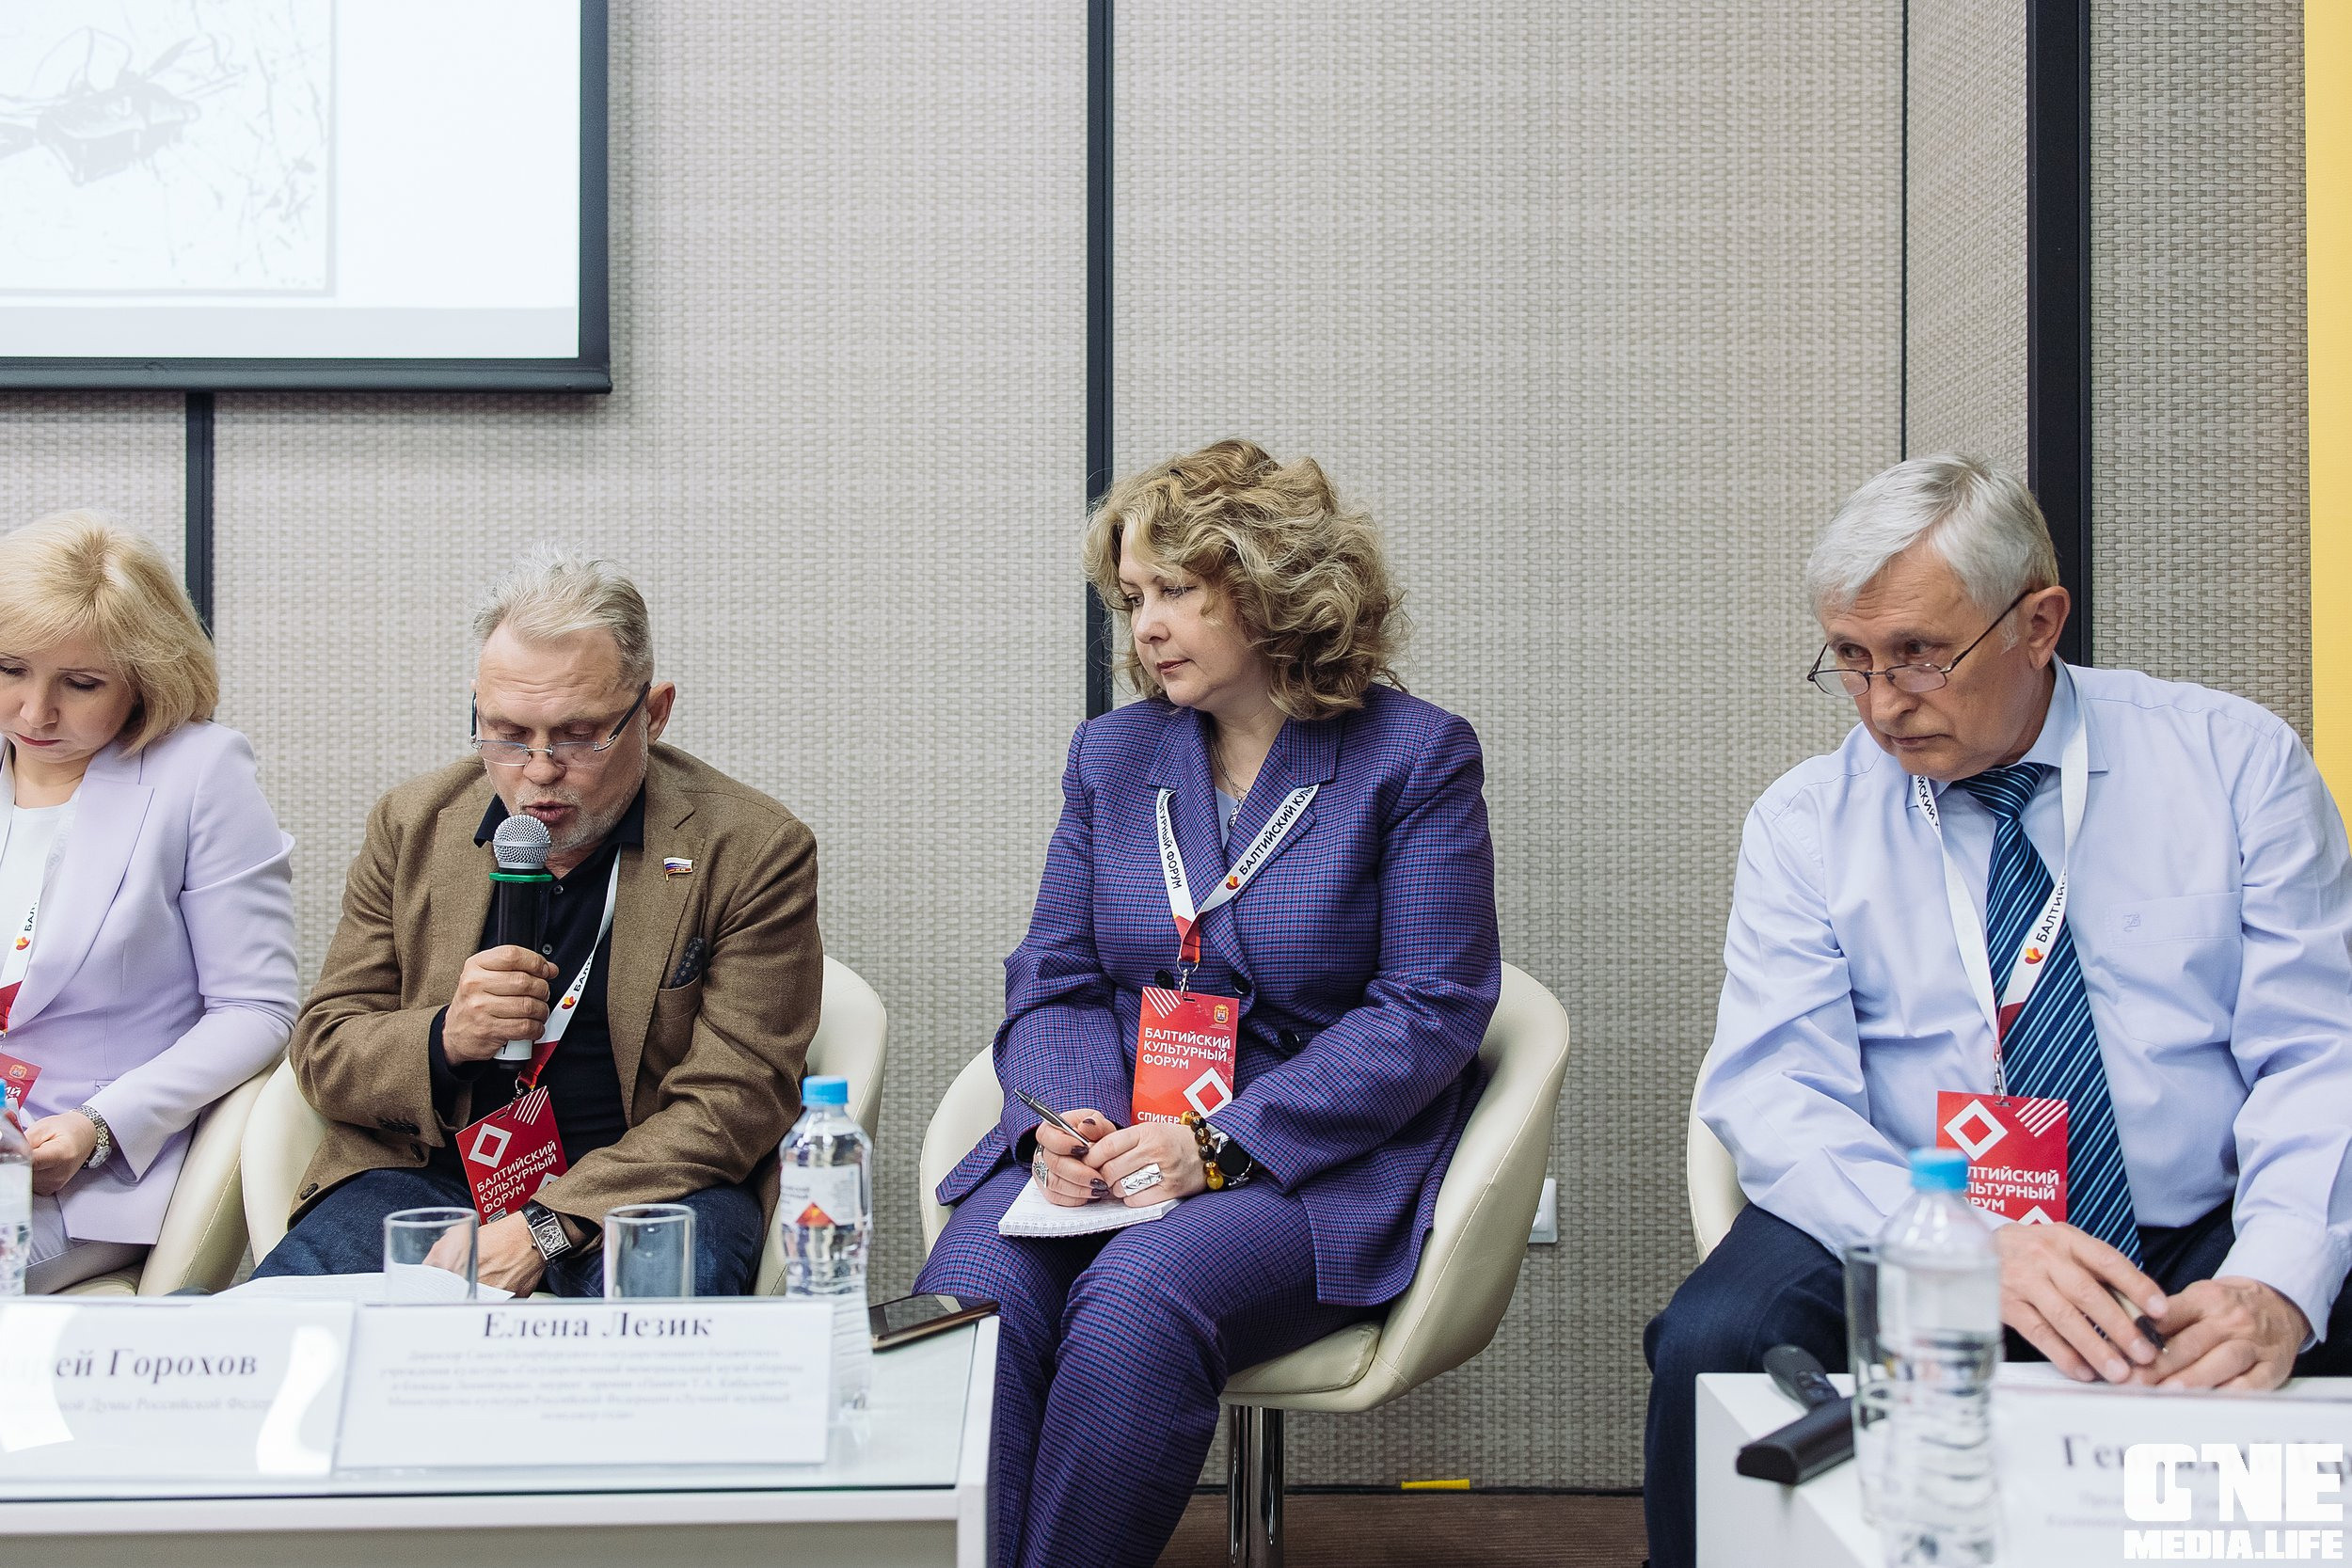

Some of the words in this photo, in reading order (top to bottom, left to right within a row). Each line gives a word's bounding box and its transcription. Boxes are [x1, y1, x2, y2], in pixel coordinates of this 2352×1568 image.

[1238, 804, 1297, 876] БАЛТИЙСКИЙ
[1166, 850, 1183, 890] ФОРУМ
[1143, 1039, 1228, 1063] КУЛЬТУРНЫЙ
[1144, 1027, 1232, 1050] БАЛТИЙСКИЙ
[1141, 1053, 1190, 1070] ФОРУМ
[1136, 1111, 1181, 1125] СПИКЕР
[476, 1139, 558, 1194] БАЛТИЙСКИЙ
[479, 1153, 558, 1205] КУЛЬТУРНЫЙ
[1965, 1164, 2059, 1185] ЛТИЙСКИЙ
[483, 1182, 526, 1214] ФОРУМ
[1964, 1181, 2056, 1201] ЛЬТУРНЫЙ
[483, 1310, 589, 1339] Елена
[602, 1310, 713, 1339] Лезик
[106, 1347, 258, 1386] Горохов
